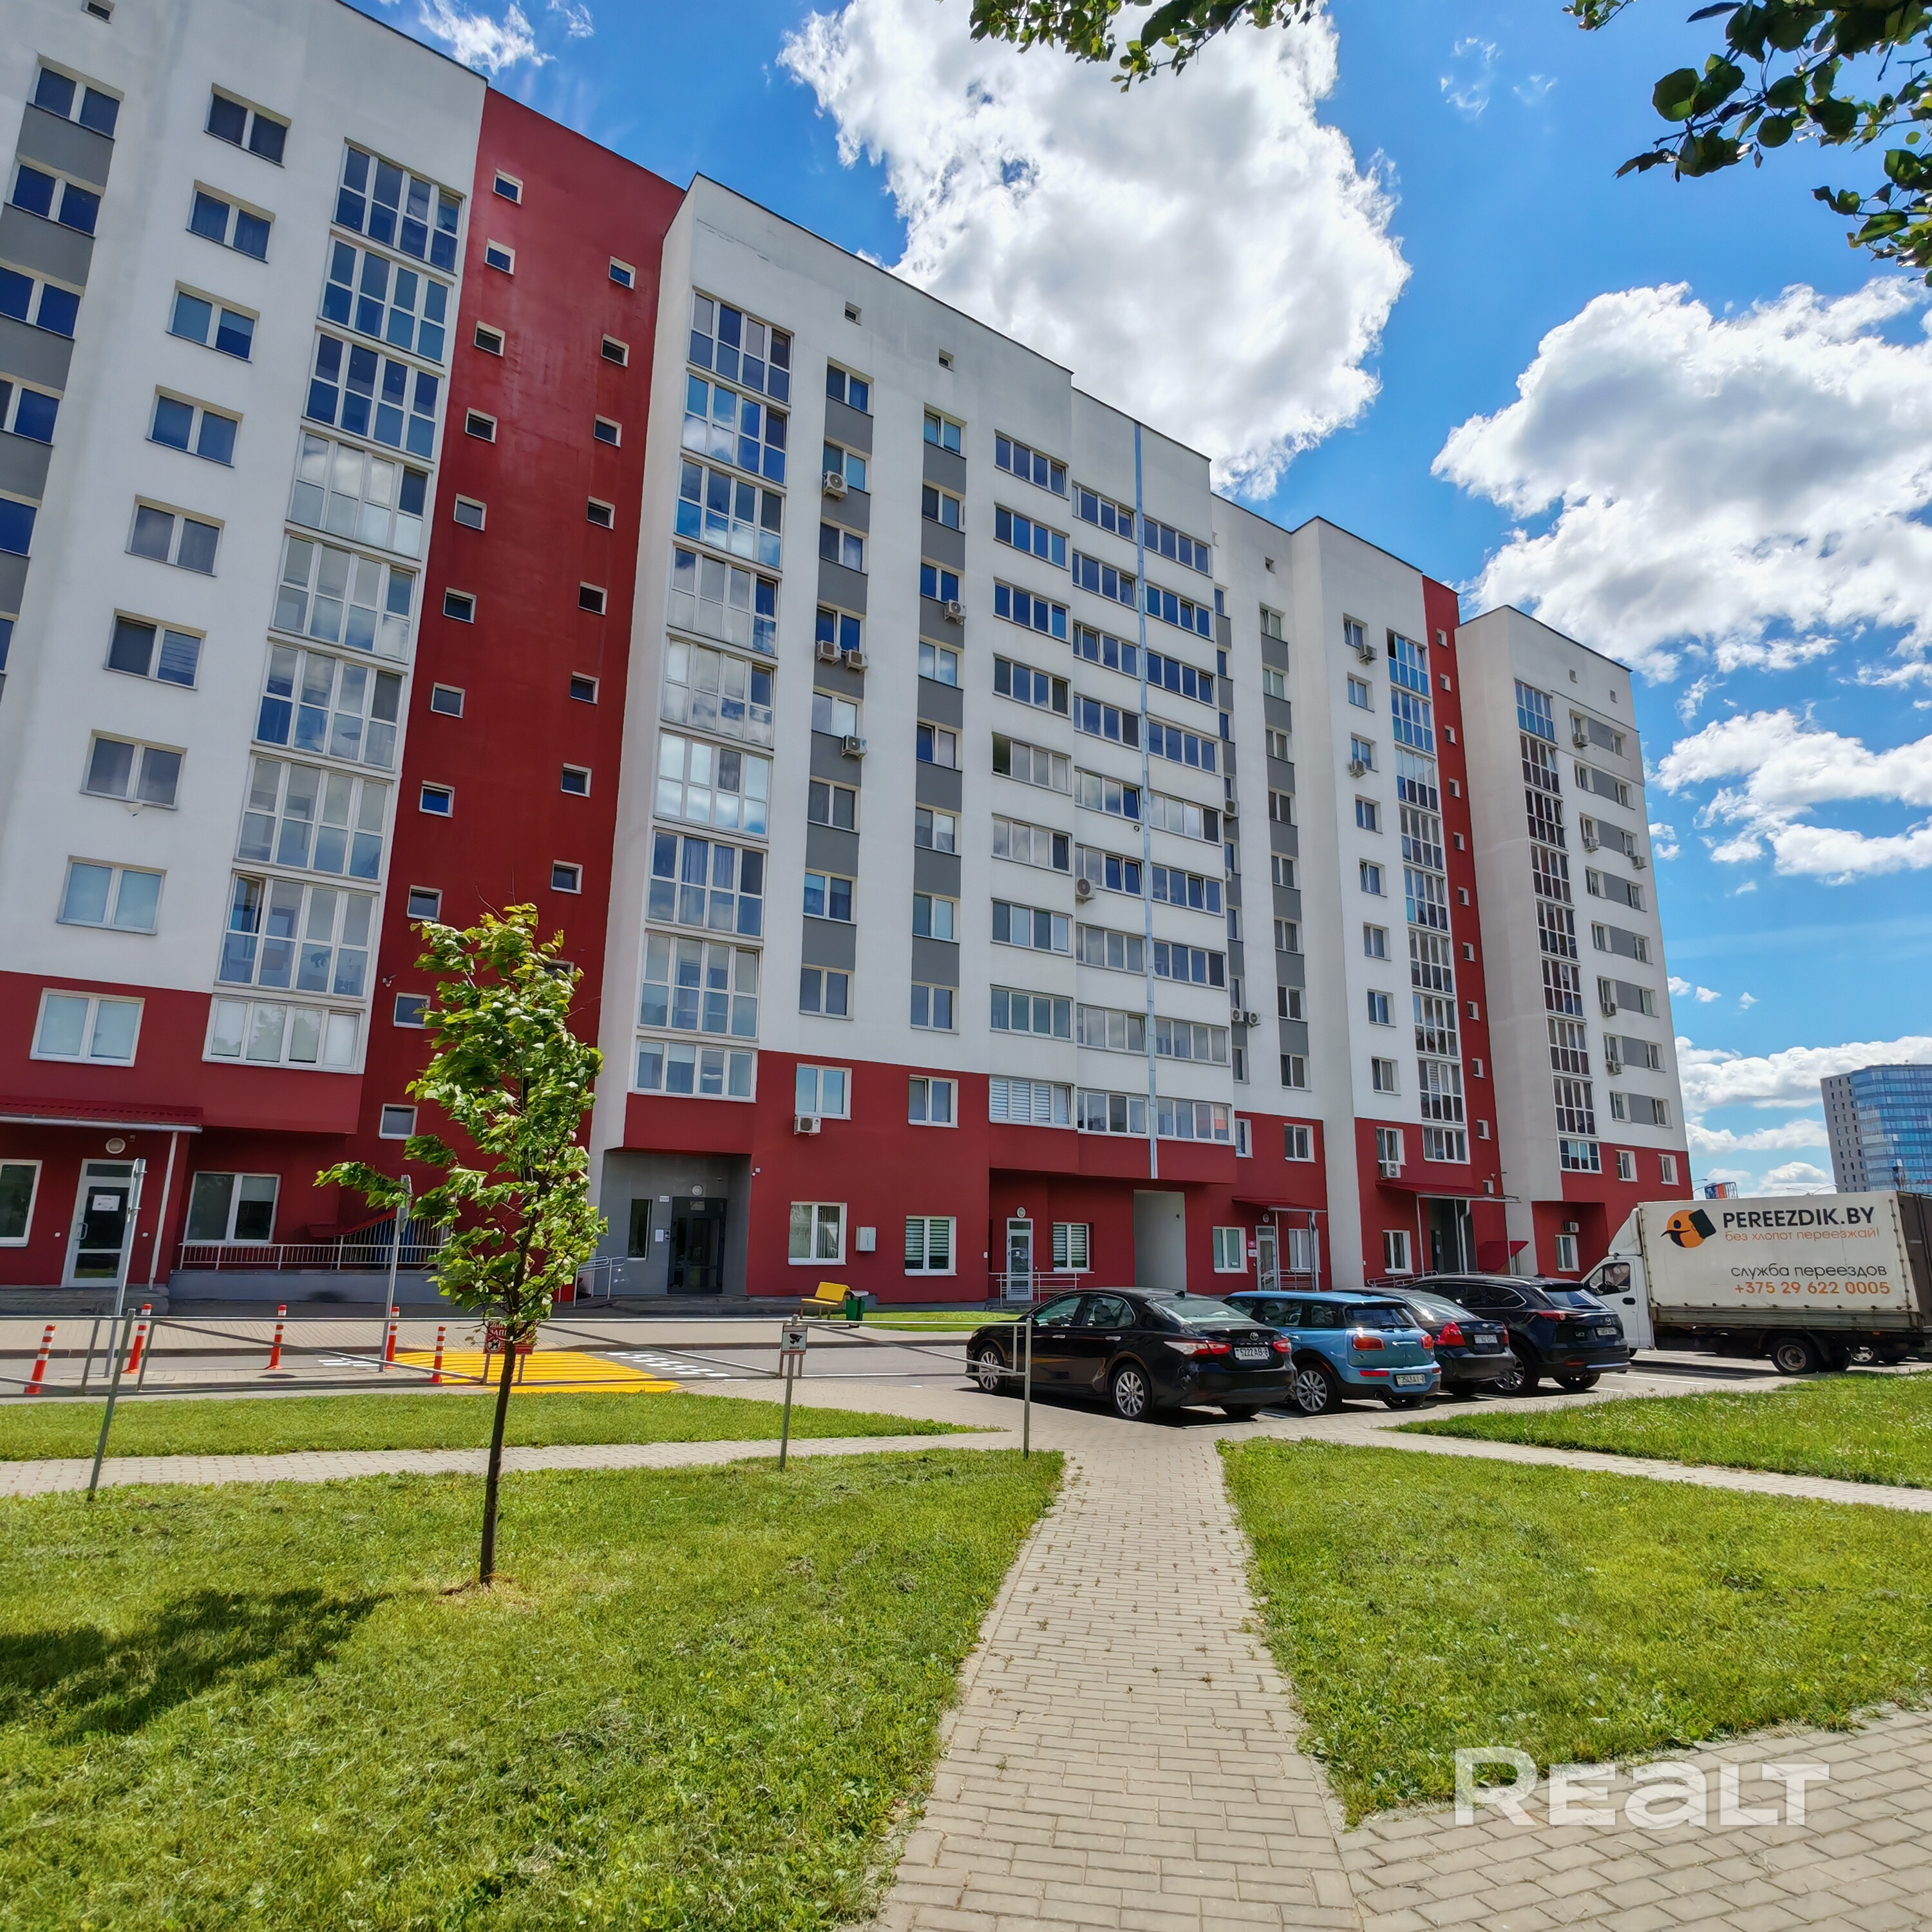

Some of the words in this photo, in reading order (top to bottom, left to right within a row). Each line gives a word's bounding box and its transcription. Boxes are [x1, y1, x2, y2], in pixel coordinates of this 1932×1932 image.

[1723, 1207, 1875, 1228] PEREEZDIK.BY
[1725, 1231, 1748, 1241] без
[1752, 1232, 1793, 1241] хлопот
[1797, 1226, 1880, 1242] переезжай!
[1731, 1264, 1789, 1280] служба
[1795, 1265, 1887, 1279] переездов
[1735, 1282, 1776, 1294] +375
[1781, 1282, 1801, 1294] 29
[1807, 1282, 1840, 1294] 622
[1844, 1282, 1891, 1294] 0005
